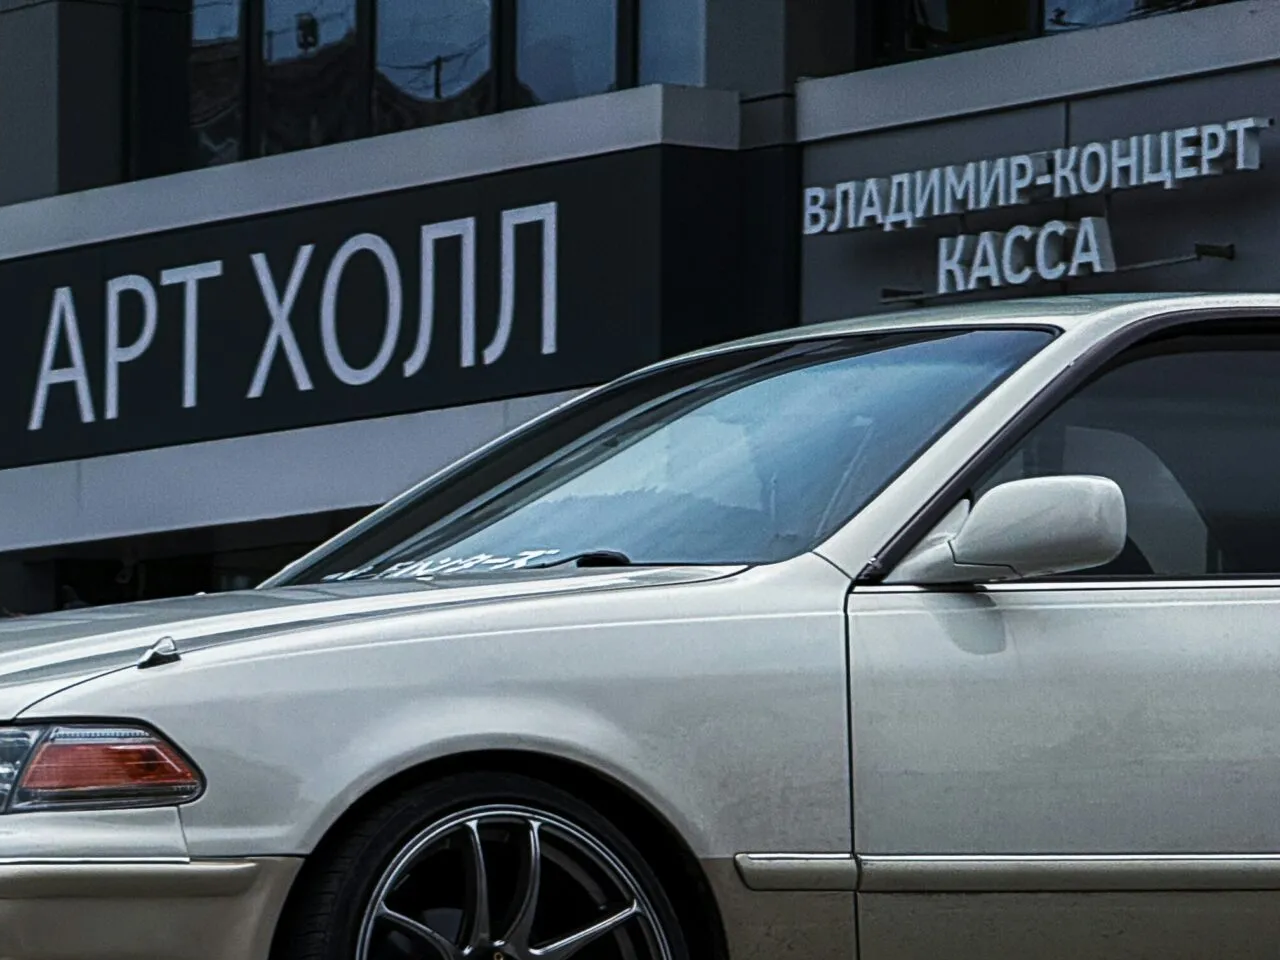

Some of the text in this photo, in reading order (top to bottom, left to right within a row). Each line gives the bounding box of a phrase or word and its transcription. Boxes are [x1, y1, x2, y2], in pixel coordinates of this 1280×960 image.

[803, 117, 1265, 234] ВЛАДИМИР-КОНЦЕРТ
[937, 217, 1113, 293] КАССА
[27, 201, 558, 431] АРТ ХОЛЛ
